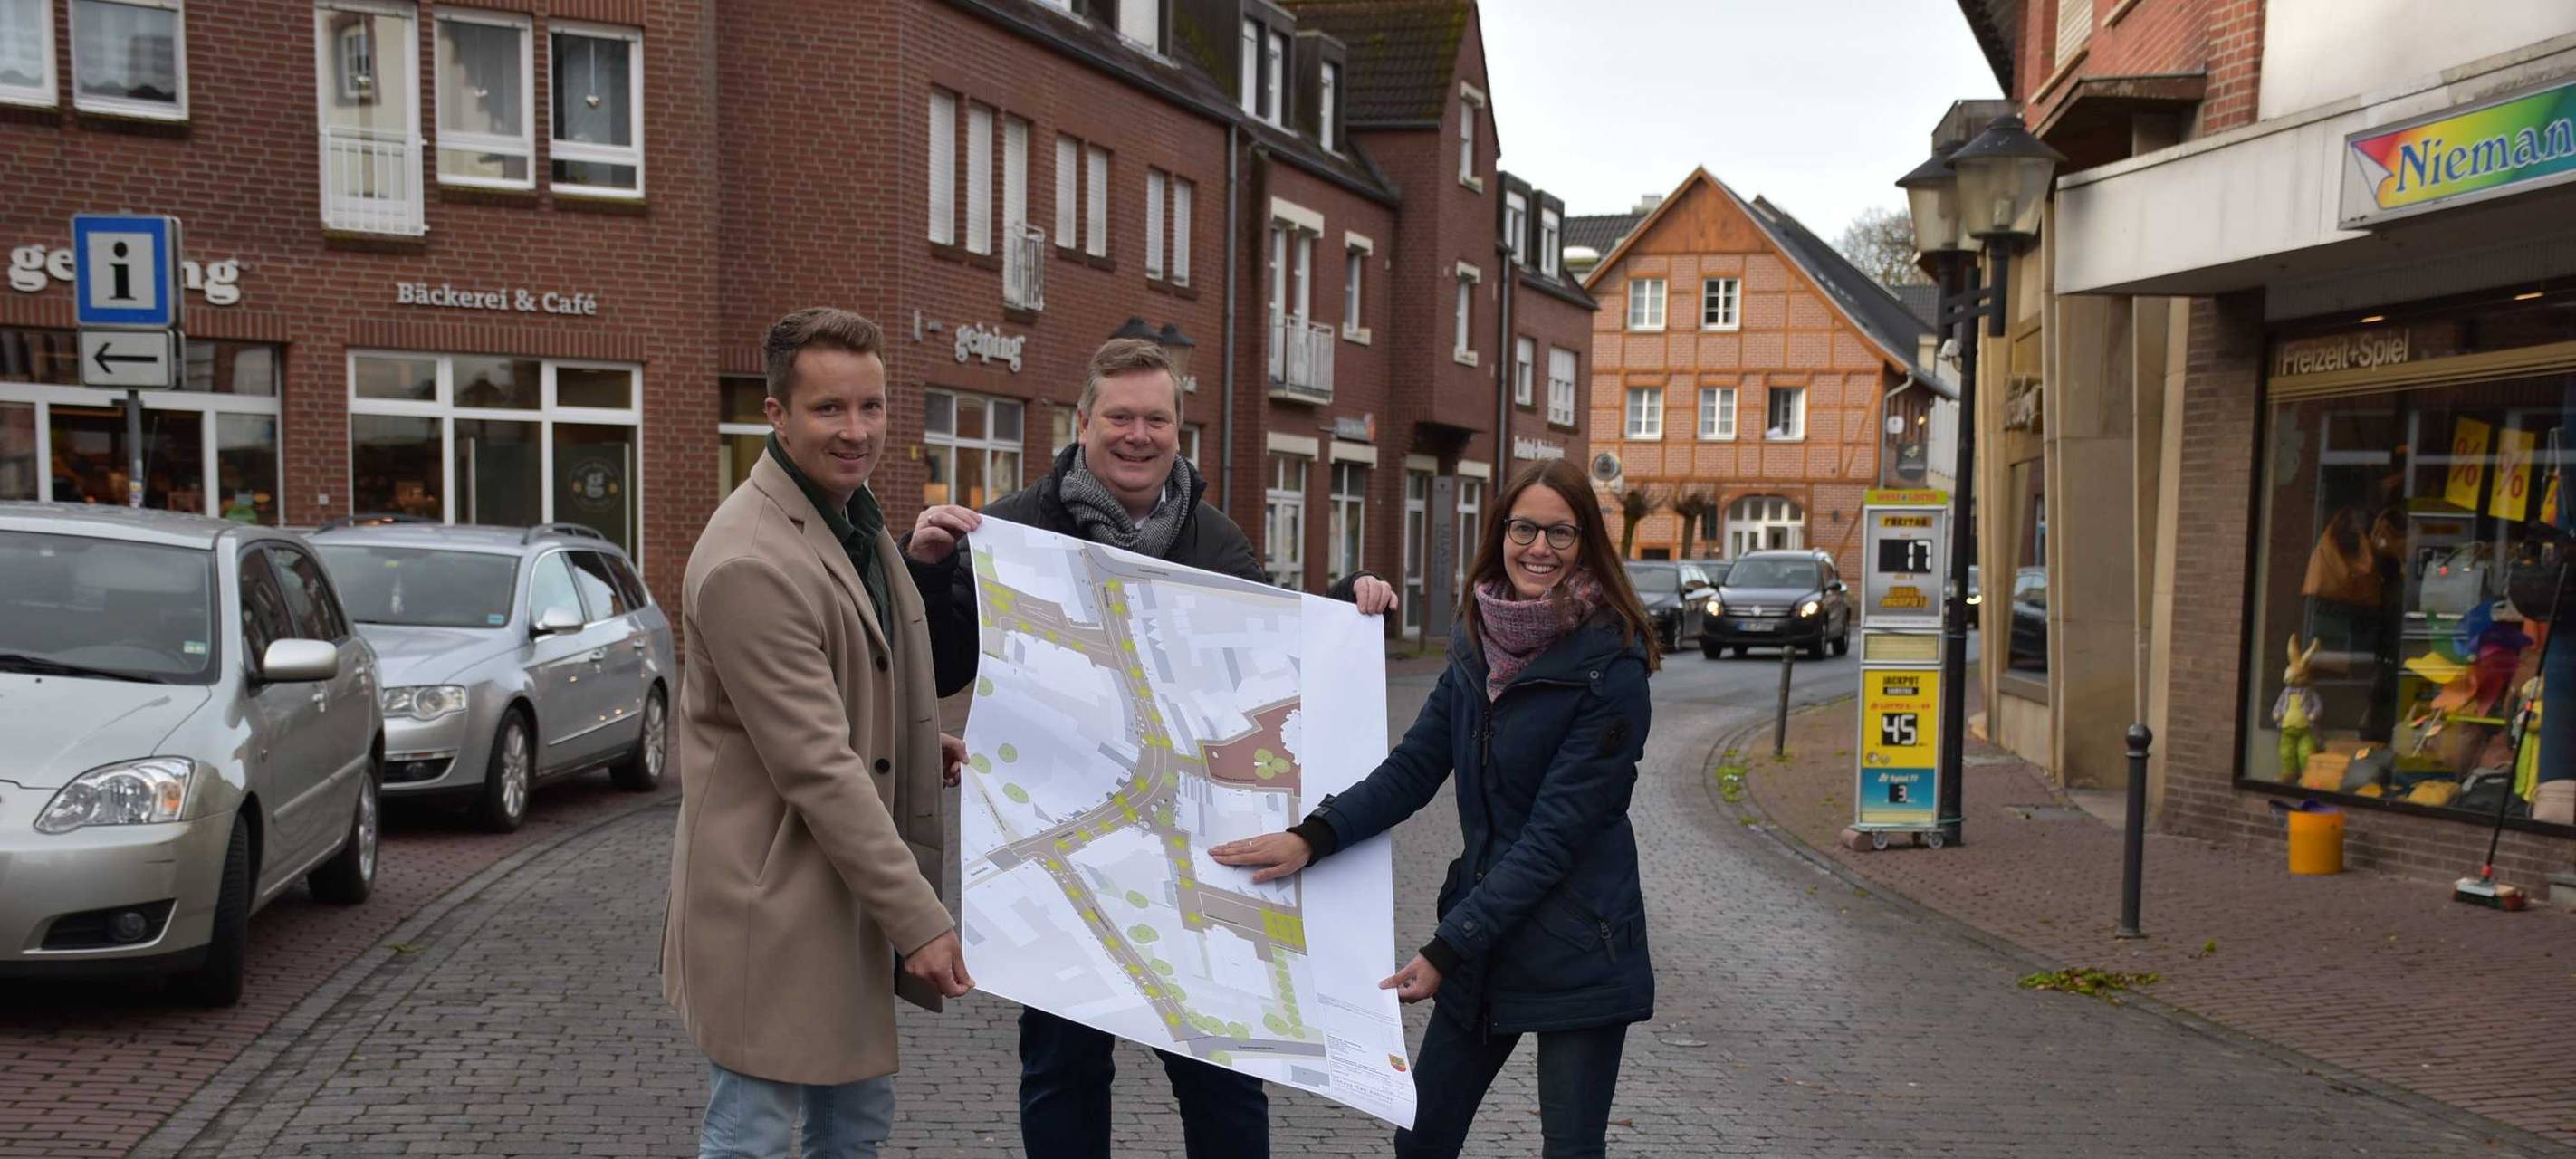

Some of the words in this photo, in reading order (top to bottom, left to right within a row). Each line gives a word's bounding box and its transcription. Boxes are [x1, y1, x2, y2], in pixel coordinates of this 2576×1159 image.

[397, 282, 509, 311] Bäckerei
[514, 288, 537, 312] &
[542, 291, 597, 316] Café
[955, 321, 1026, 372] geiping
[2281, 328, 2410, 376] Freizeit+Spiel
[1908, 541, 1931, 570] 17
[1883, 676, 1920, 686] JACKPOT
[1882, 714, 1917, 744] 45
[1898, 785, 1907, 802] 3
